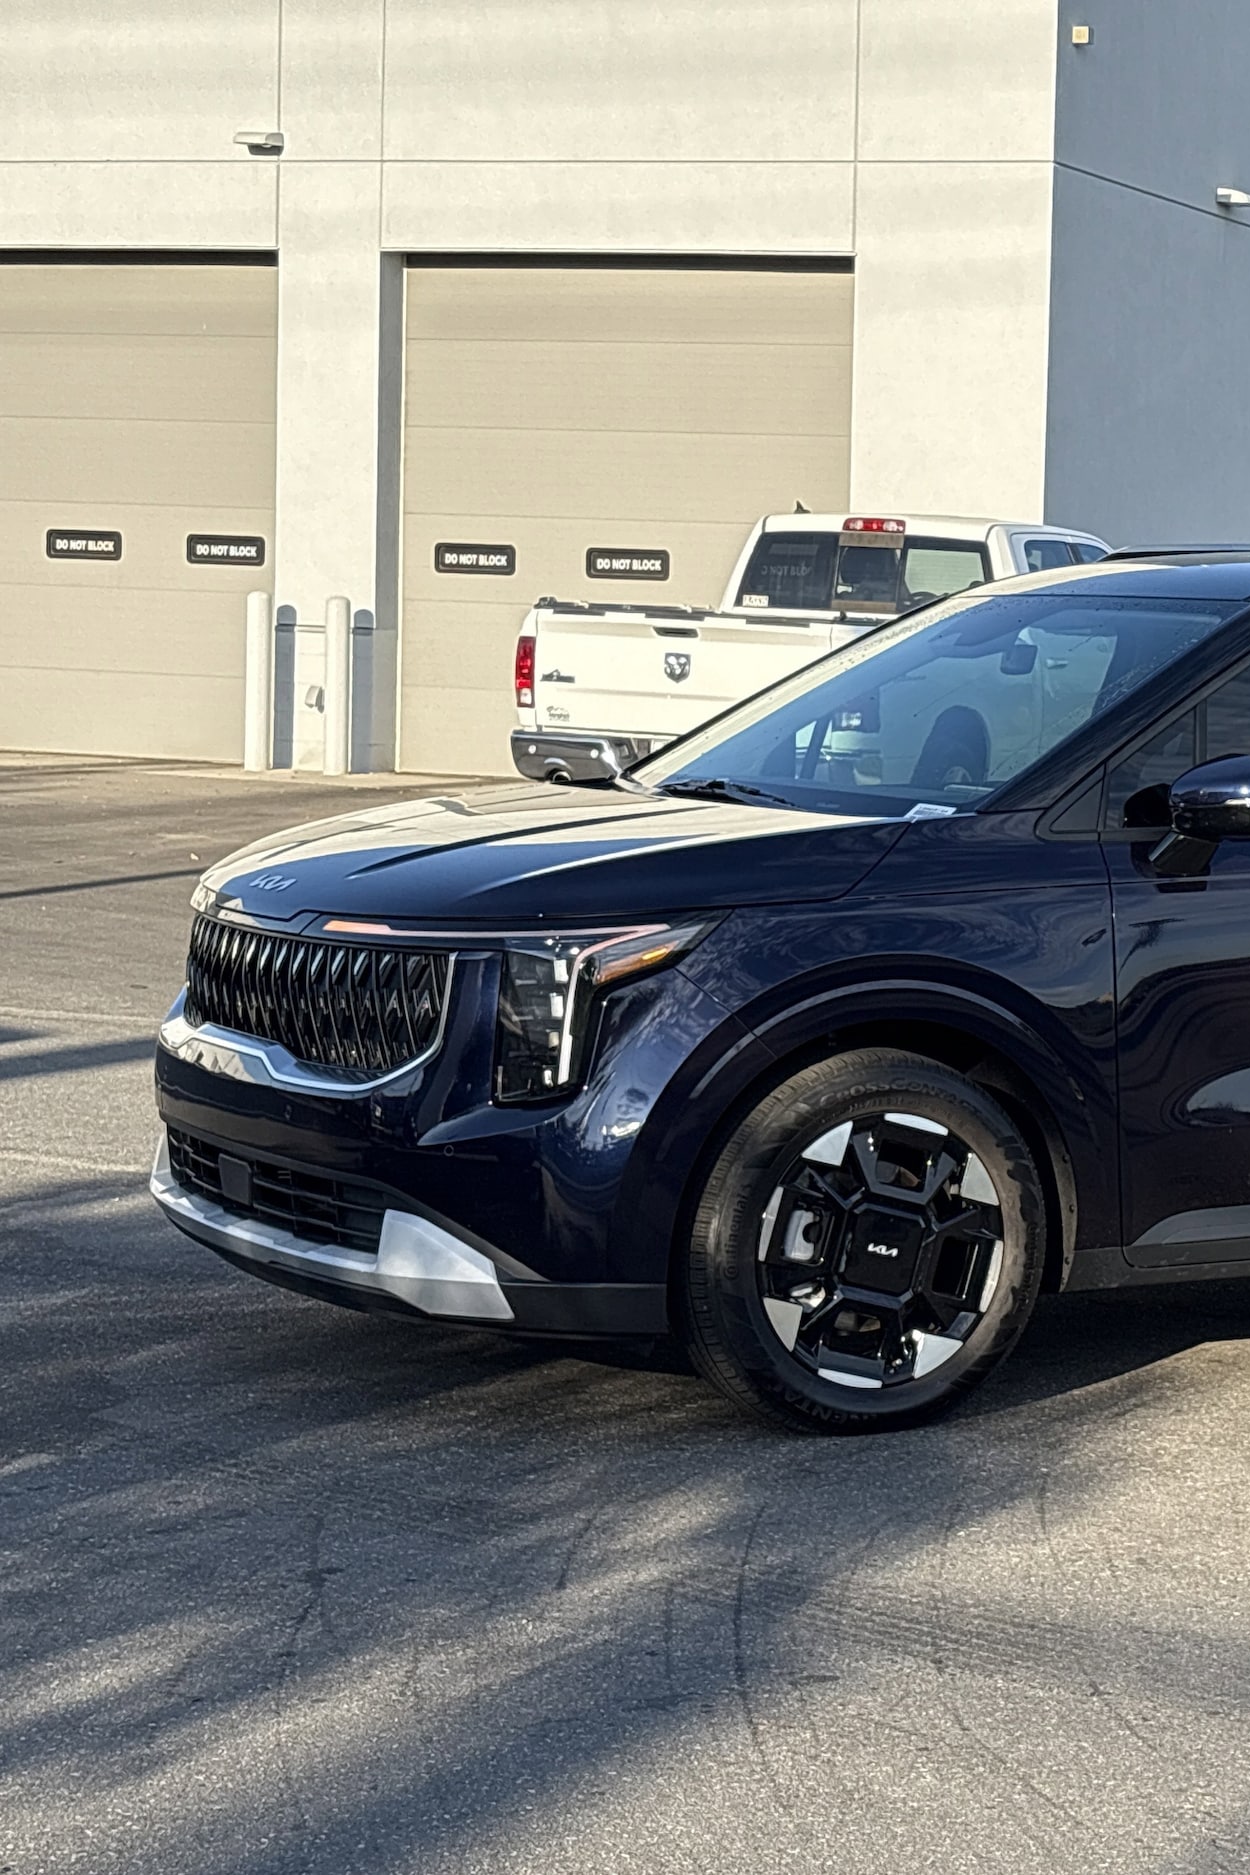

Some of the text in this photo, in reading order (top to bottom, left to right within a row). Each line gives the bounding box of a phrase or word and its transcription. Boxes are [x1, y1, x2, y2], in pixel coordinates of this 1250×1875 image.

[56, 539, 115, 552] DO NOT BLOCK
[196, 544, 257, 558] DO NOT BLOCK
[444, 553, 507, 567] DO NOT BLOCK
[596, 558, 662, 571] DO NOT BLOCK
[248, 873, 297, 892] KIA
[867, 1242, 899, 1258] KIA
